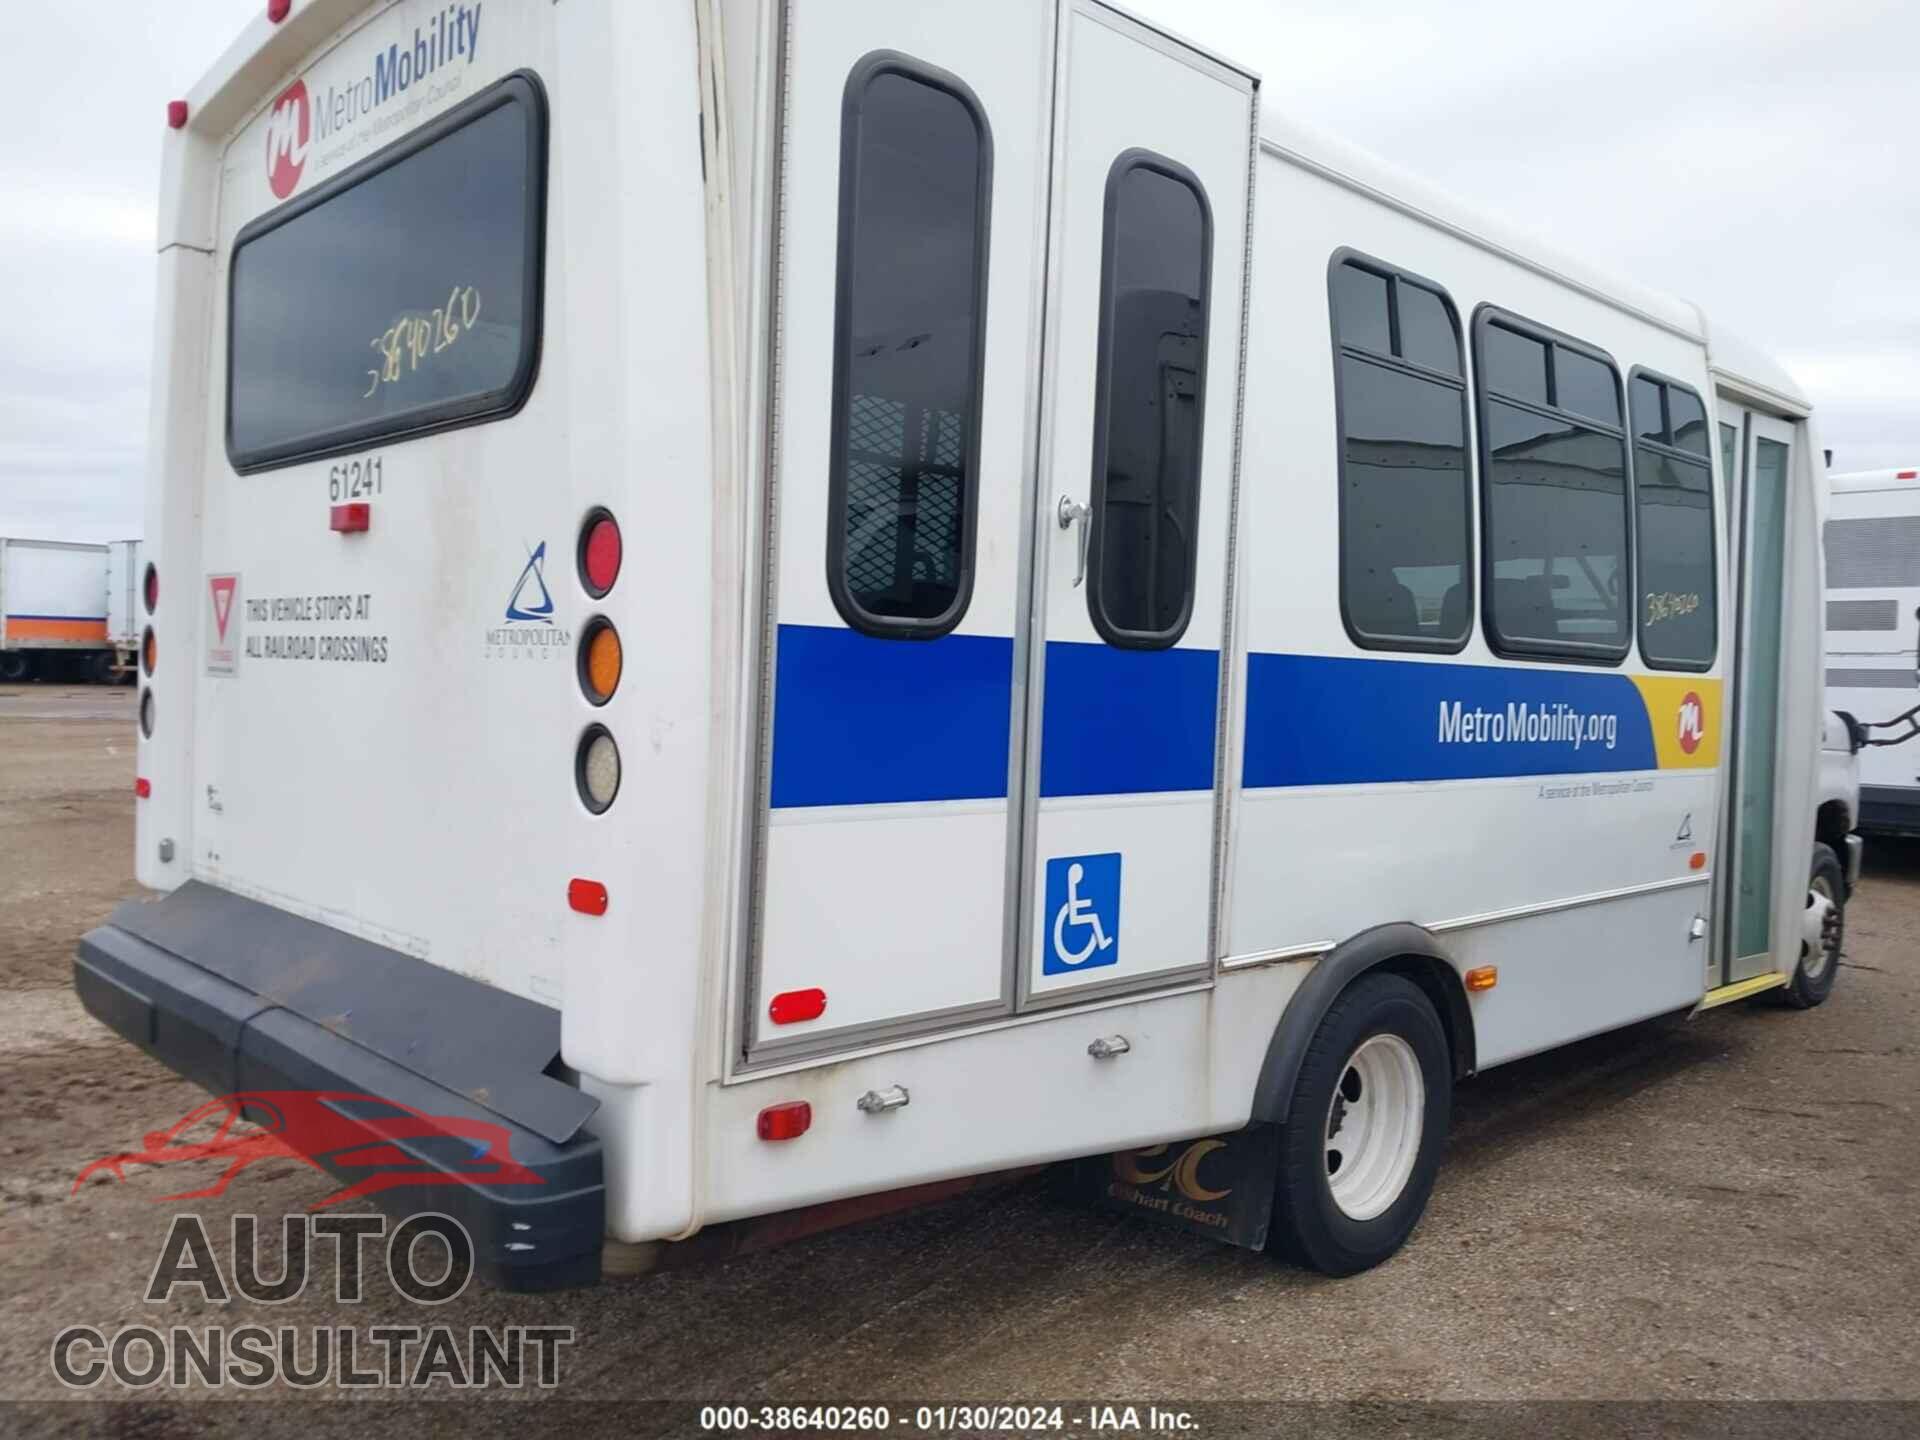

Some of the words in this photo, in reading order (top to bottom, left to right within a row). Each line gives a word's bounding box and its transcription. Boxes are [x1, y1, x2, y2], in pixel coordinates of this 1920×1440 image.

[314, 2, 481, 145] MetroMobility
[329, 457, 383, 502] 61241
[247, 598, 268, 622] THIS
[271, 597, 312, 622] VEHICLE
[315, 595, 352, 621] STOPS
[354, 594, 371, 620] AT
[246, 636, 262, 658] ALL
[264, 635, 316, 660] RAILROAD
[318, 636, 388, 663] CROSSINGS
[1437, 700, 1618, 751] MetroMobility.org
[1172, 1202, 1229, 1228] Coach
